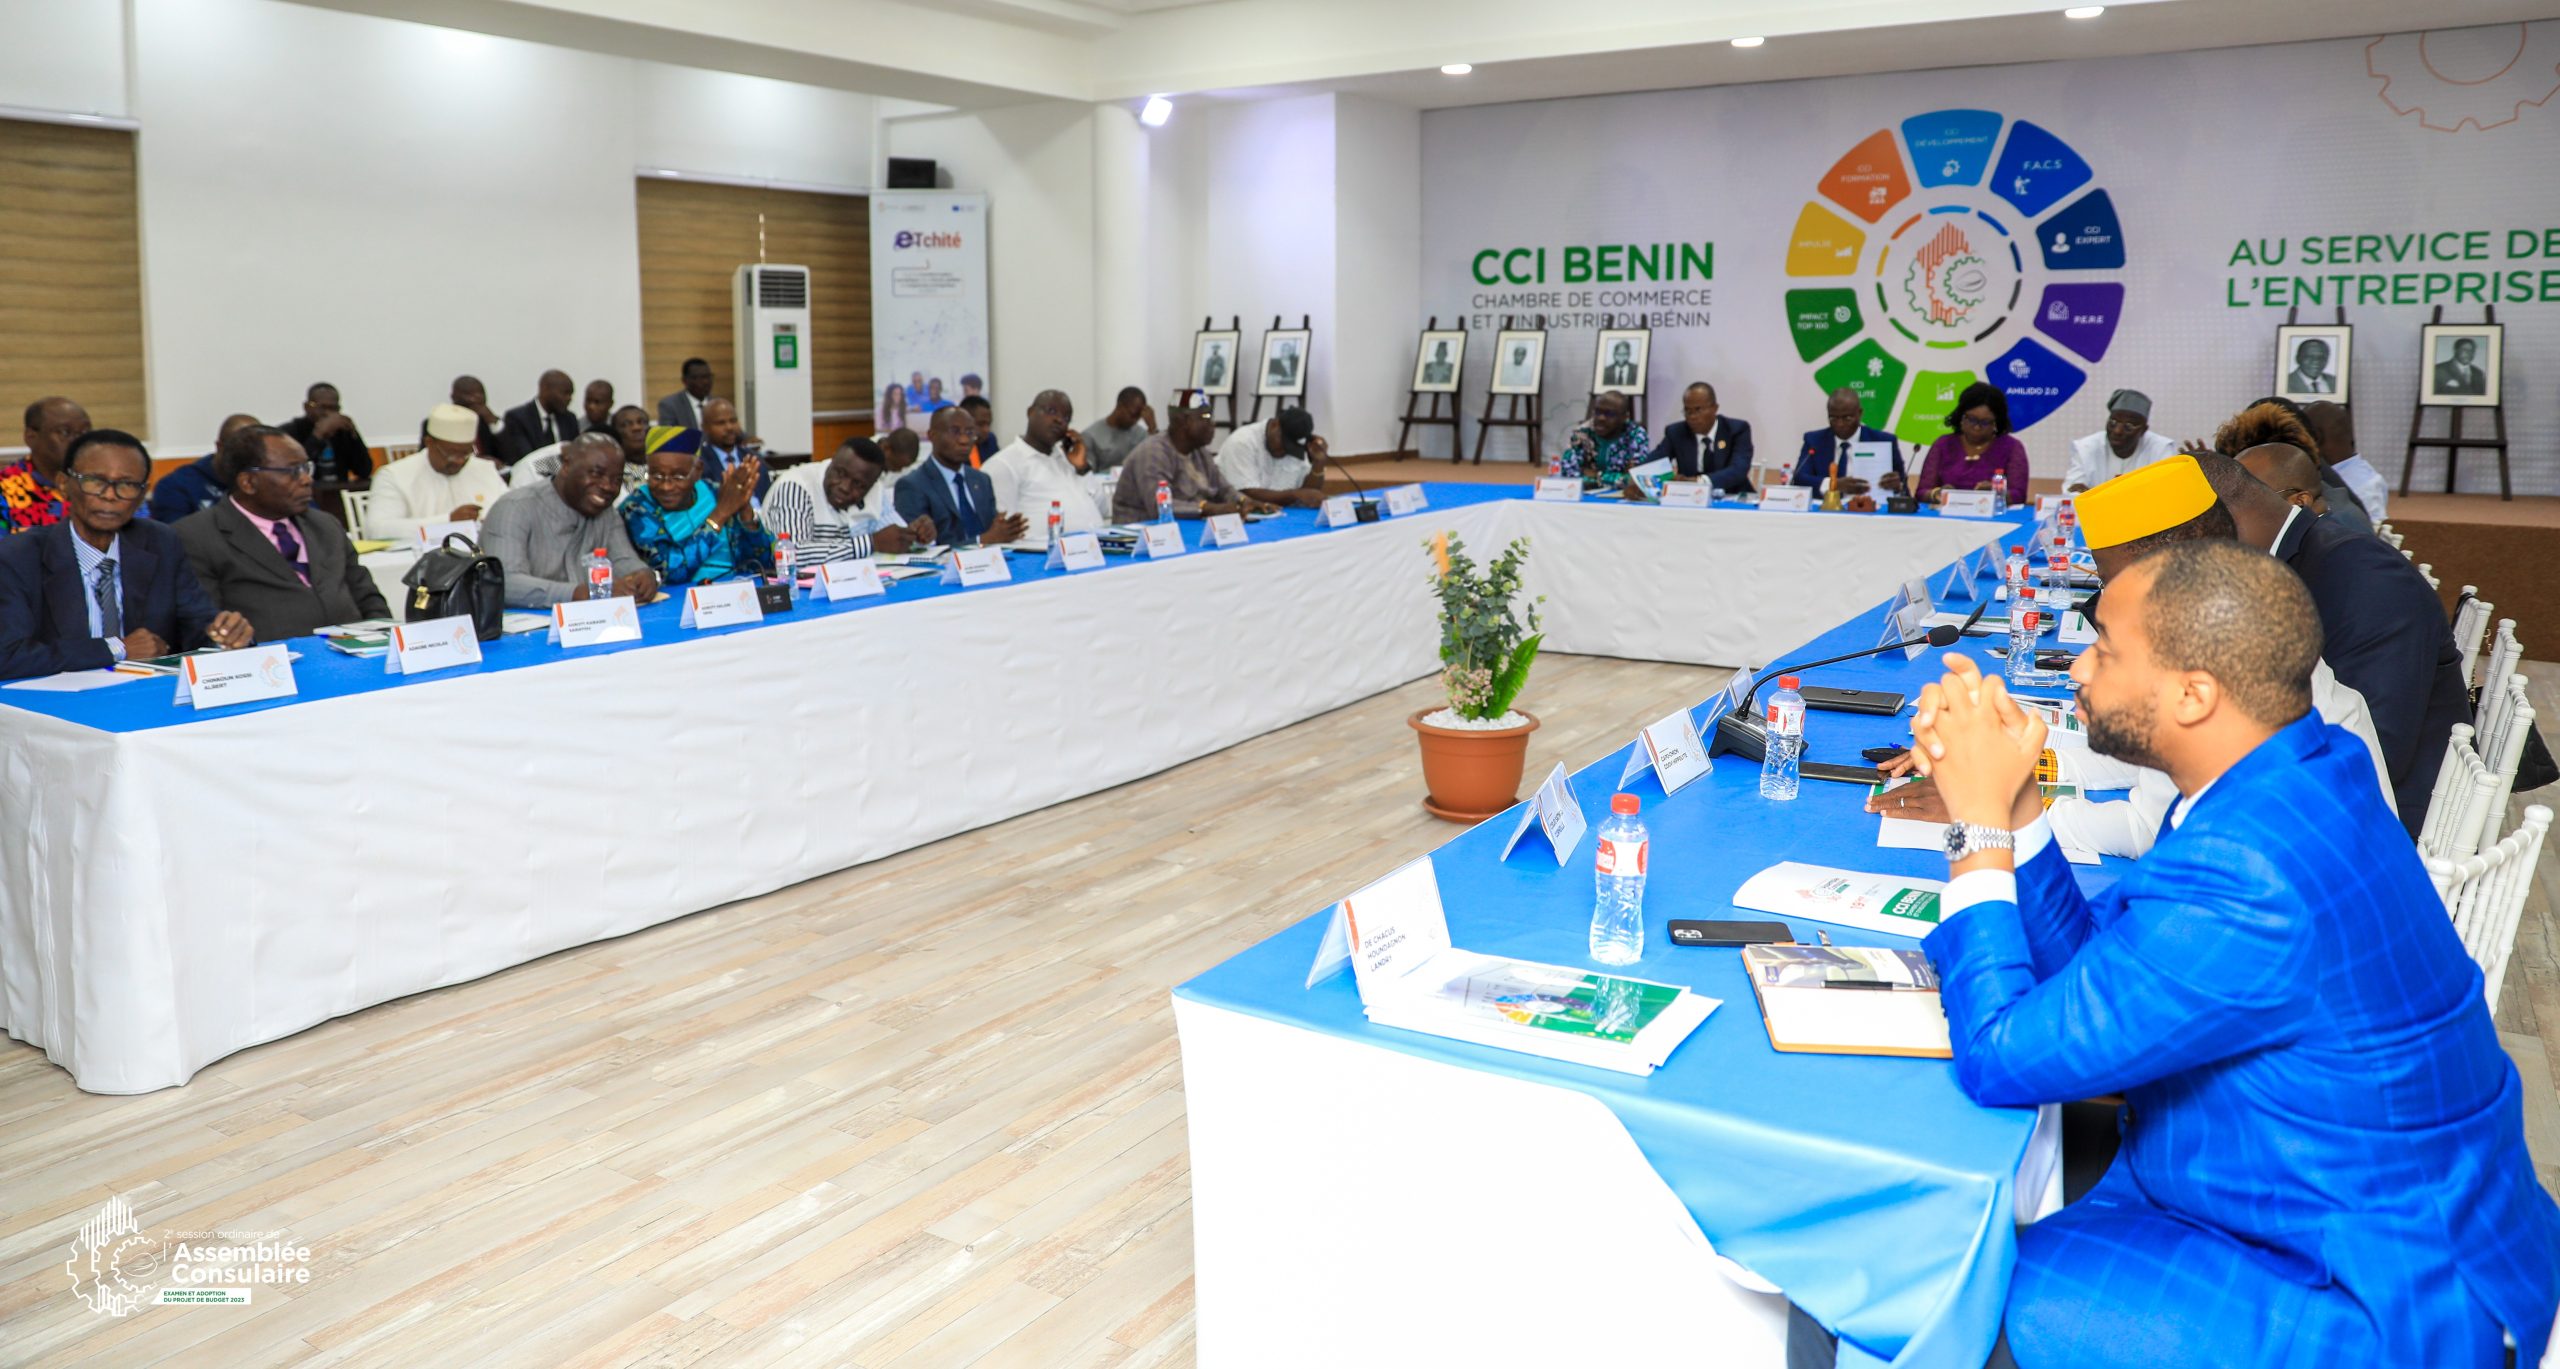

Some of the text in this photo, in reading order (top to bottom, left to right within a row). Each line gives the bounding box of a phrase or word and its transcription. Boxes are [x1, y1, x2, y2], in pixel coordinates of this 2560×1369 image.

[2075, 236, 2111, 245] EXPERT
[2228, 229, 2560, 266] AU SERVICE DE
[1472, 242, 1714, 285] CCI BENIN
[2227, 270, 2560, 307] L'ENTREPRISE
[1472, 289, 1712, 309] CHAMBRE DE COMMERCE
[1472, 314, 1493, 330] ET
[1651, 309, 1711, 328] BÉNIN
[1364, 939, 1372, 949] DE
[1371, 955, 1392, 972] LANDRY
